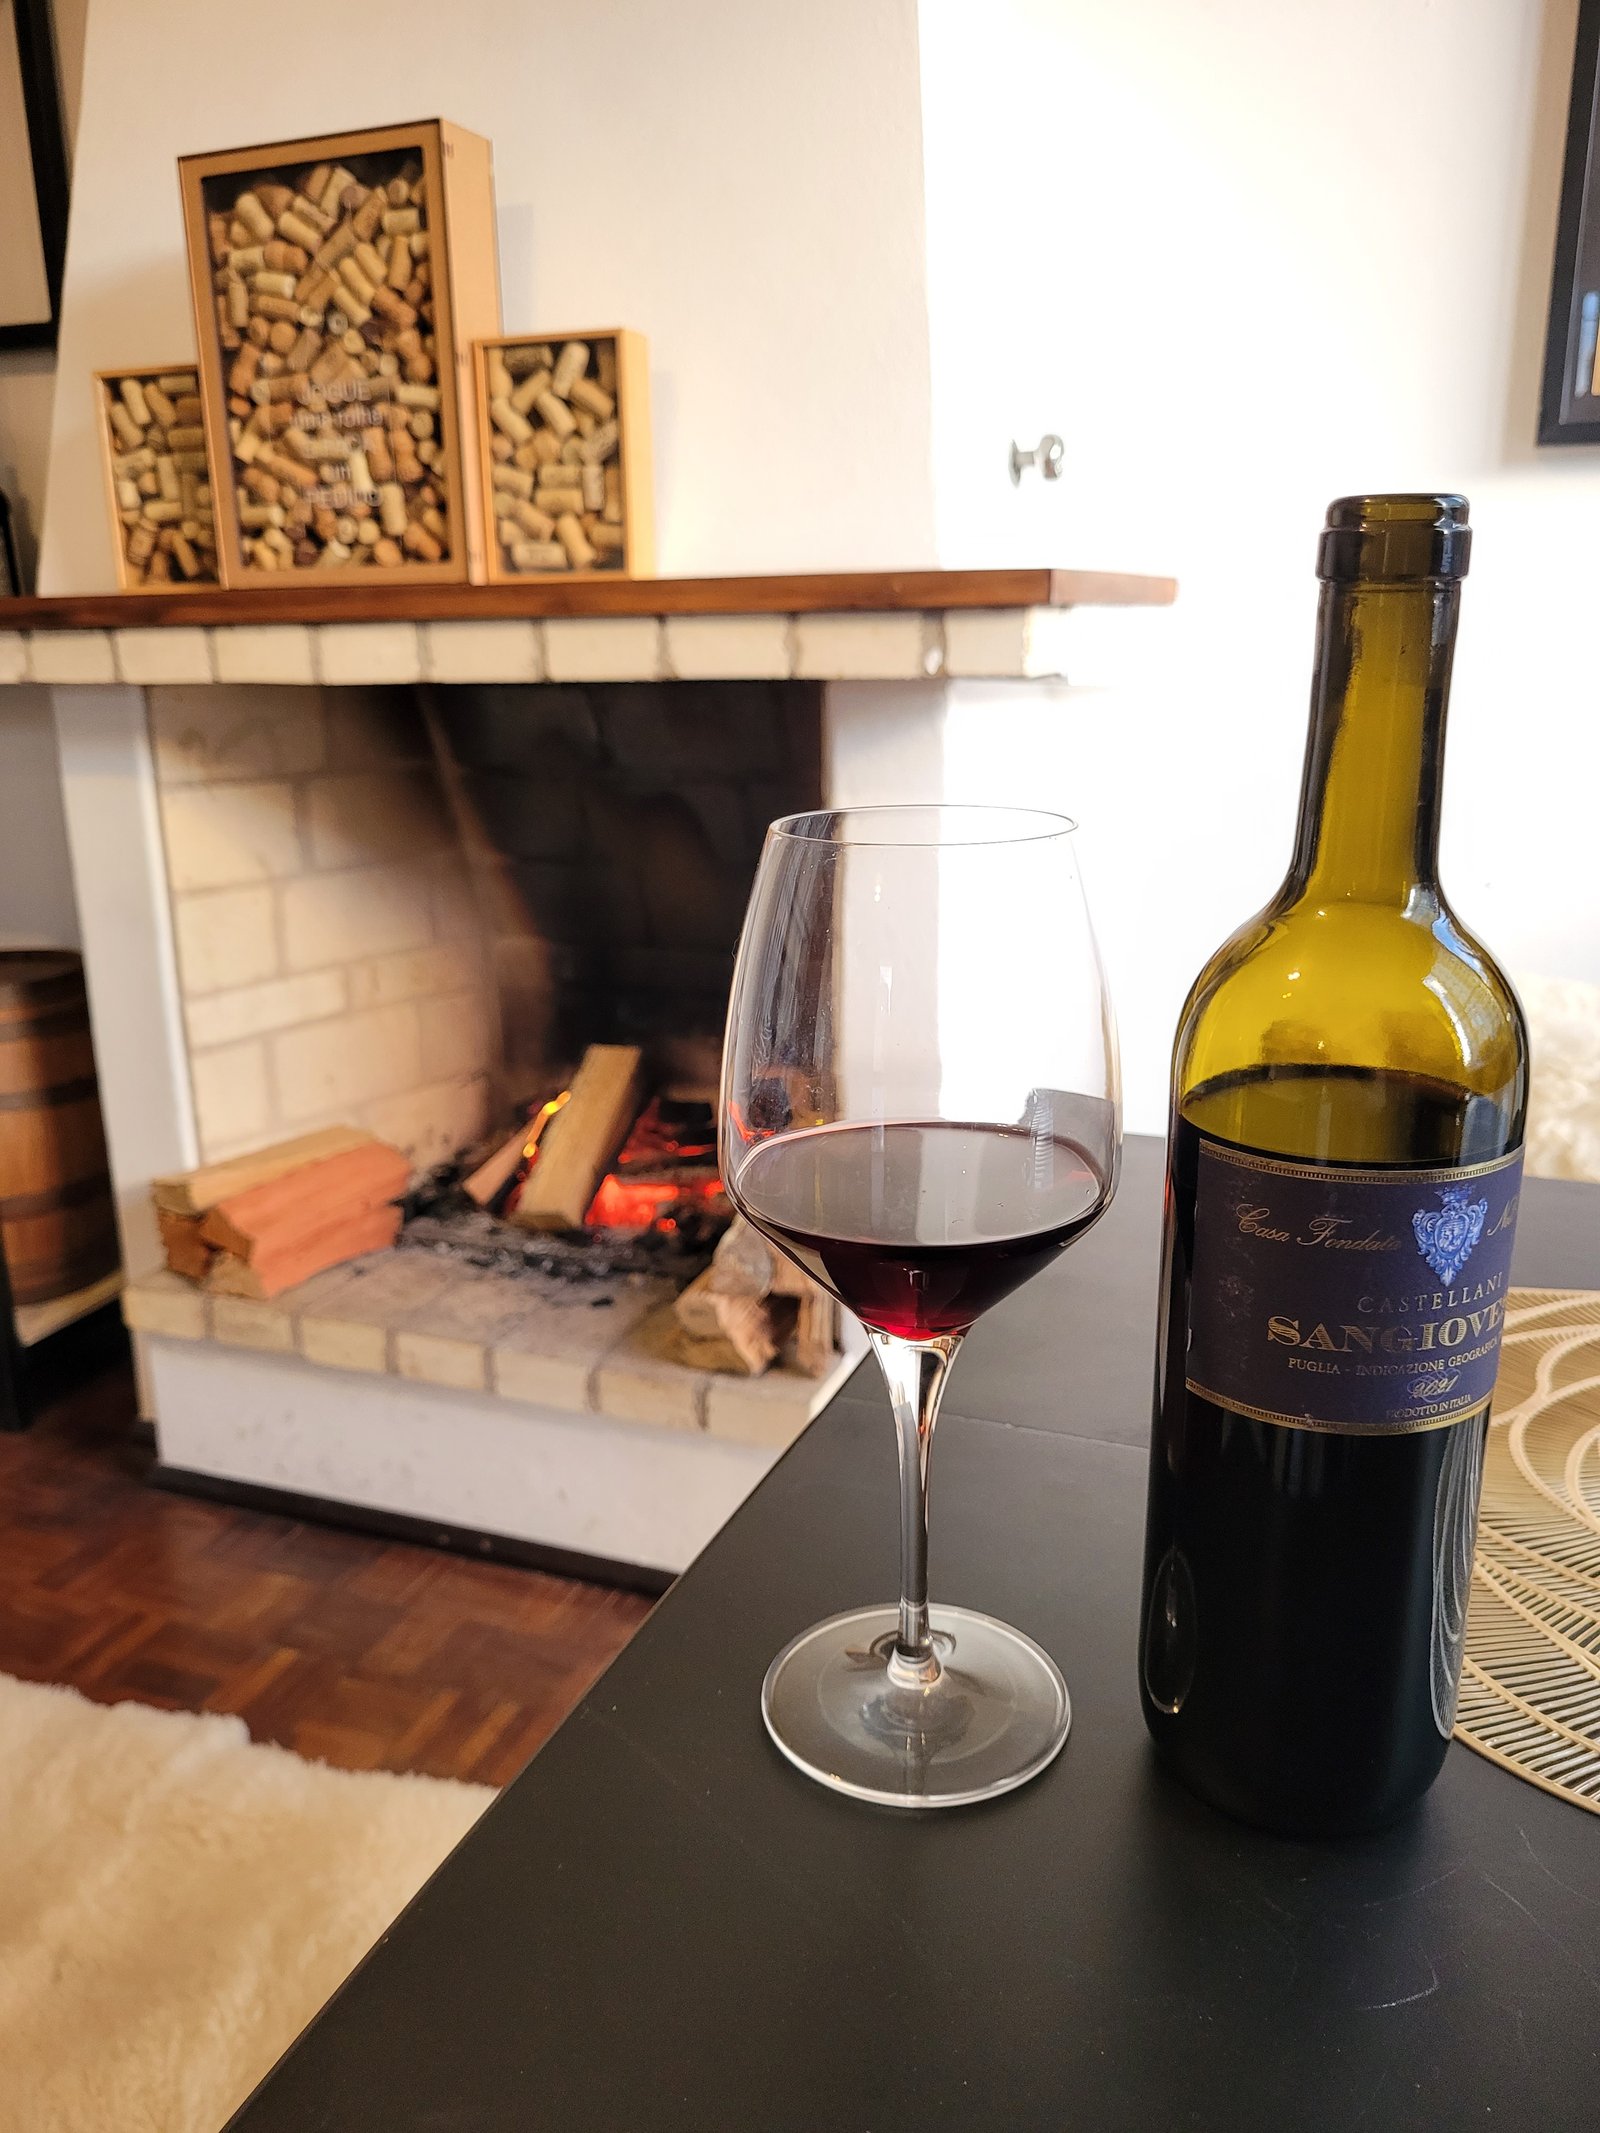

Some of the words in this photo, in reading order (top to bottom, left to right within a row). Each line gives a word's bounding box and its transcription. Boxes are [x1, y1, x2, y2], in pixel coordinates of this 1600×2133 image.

[1236, 1203, 1290, 1242] Casa
[1296, 1217, 1402, 1251] Fondata
[1358, 1272, 1502, 1313] CASTELLANI
[1267, 1298, 1505, 1354] SANGIOVE
[1288, 1357, 1341, 1376] PUGLIA
[1356, 1358, 1444, 1376] INDICAZIONE
[1439, 1401, 1450, 1412] IN
[1450, 1394, 1472, 1408] ITALIA
